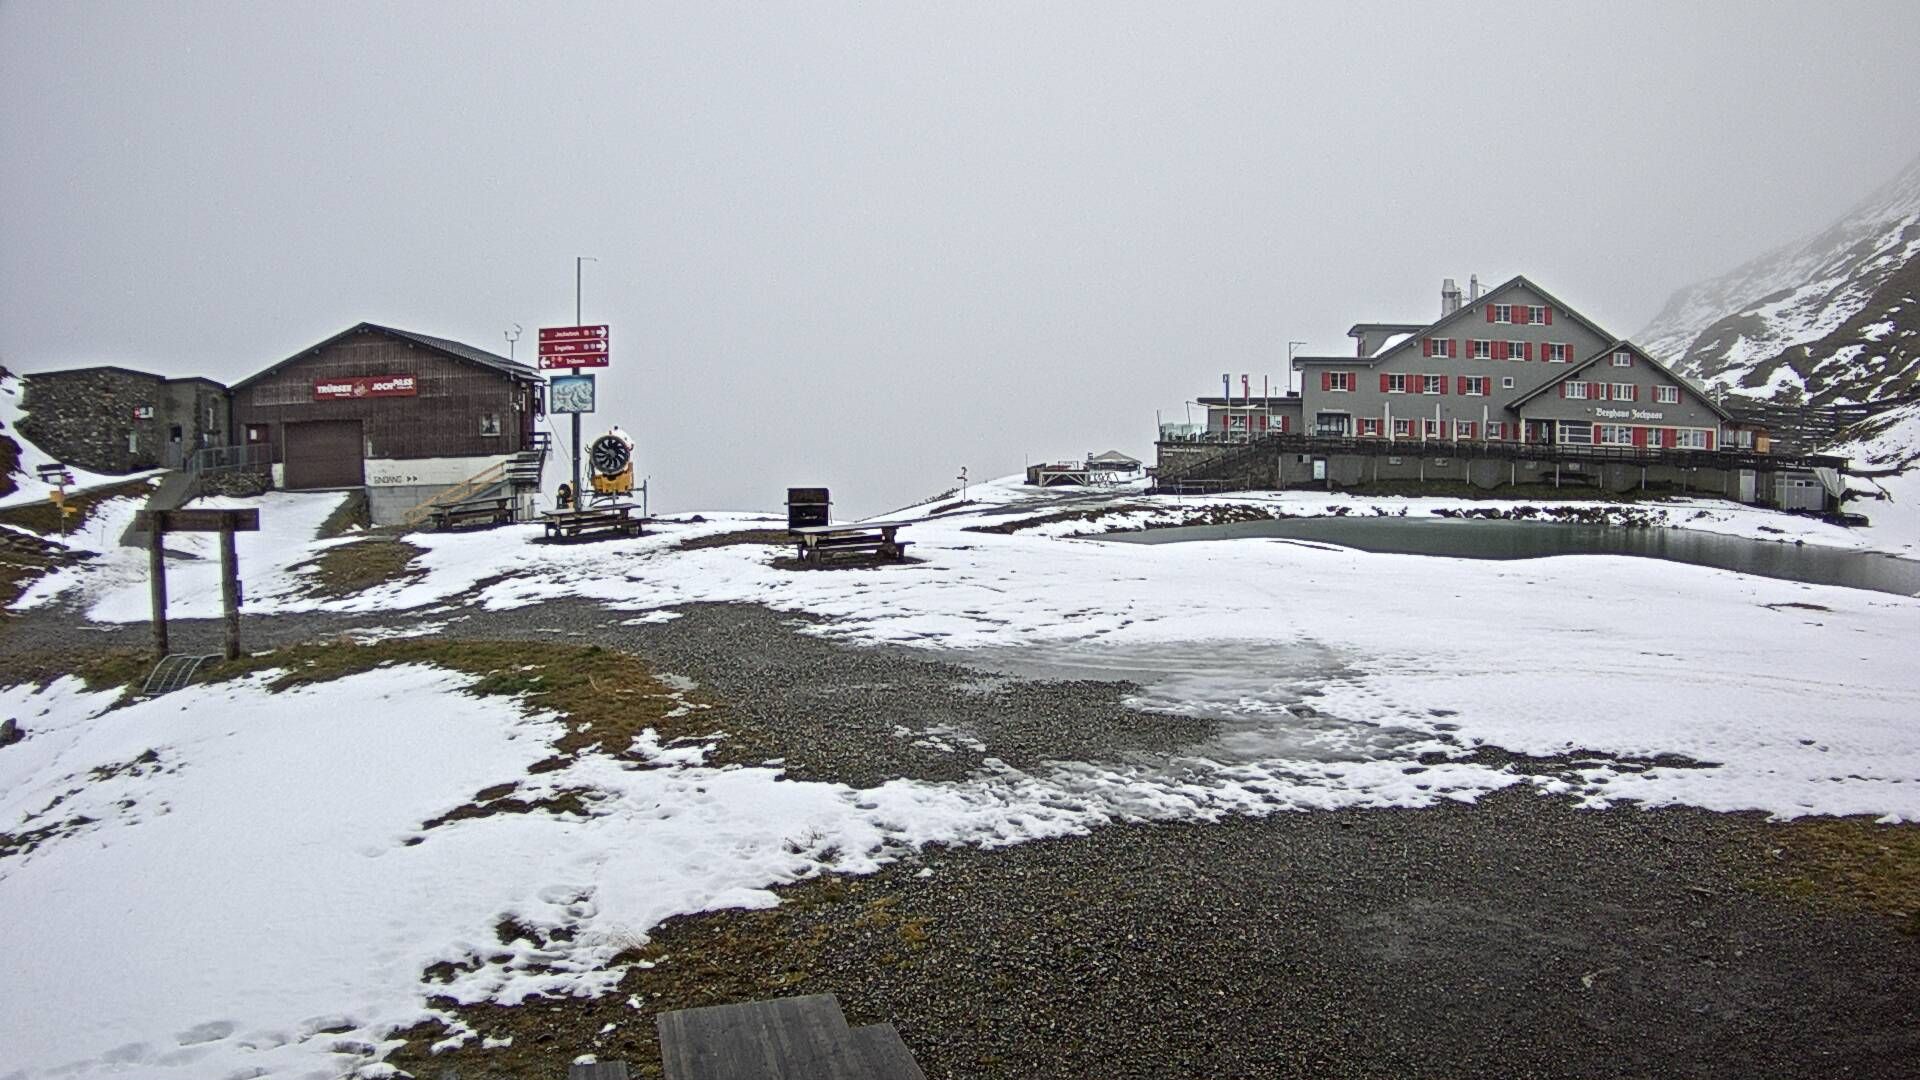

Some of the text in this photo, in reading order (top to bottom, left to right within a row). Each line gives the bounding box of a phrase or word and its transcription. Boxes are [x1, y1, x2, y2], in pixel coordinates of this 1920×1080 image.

[317, 384, 352, 394] TRÜBSEE
[1595, 407, 1663, 420] Berghaus Jochpass
